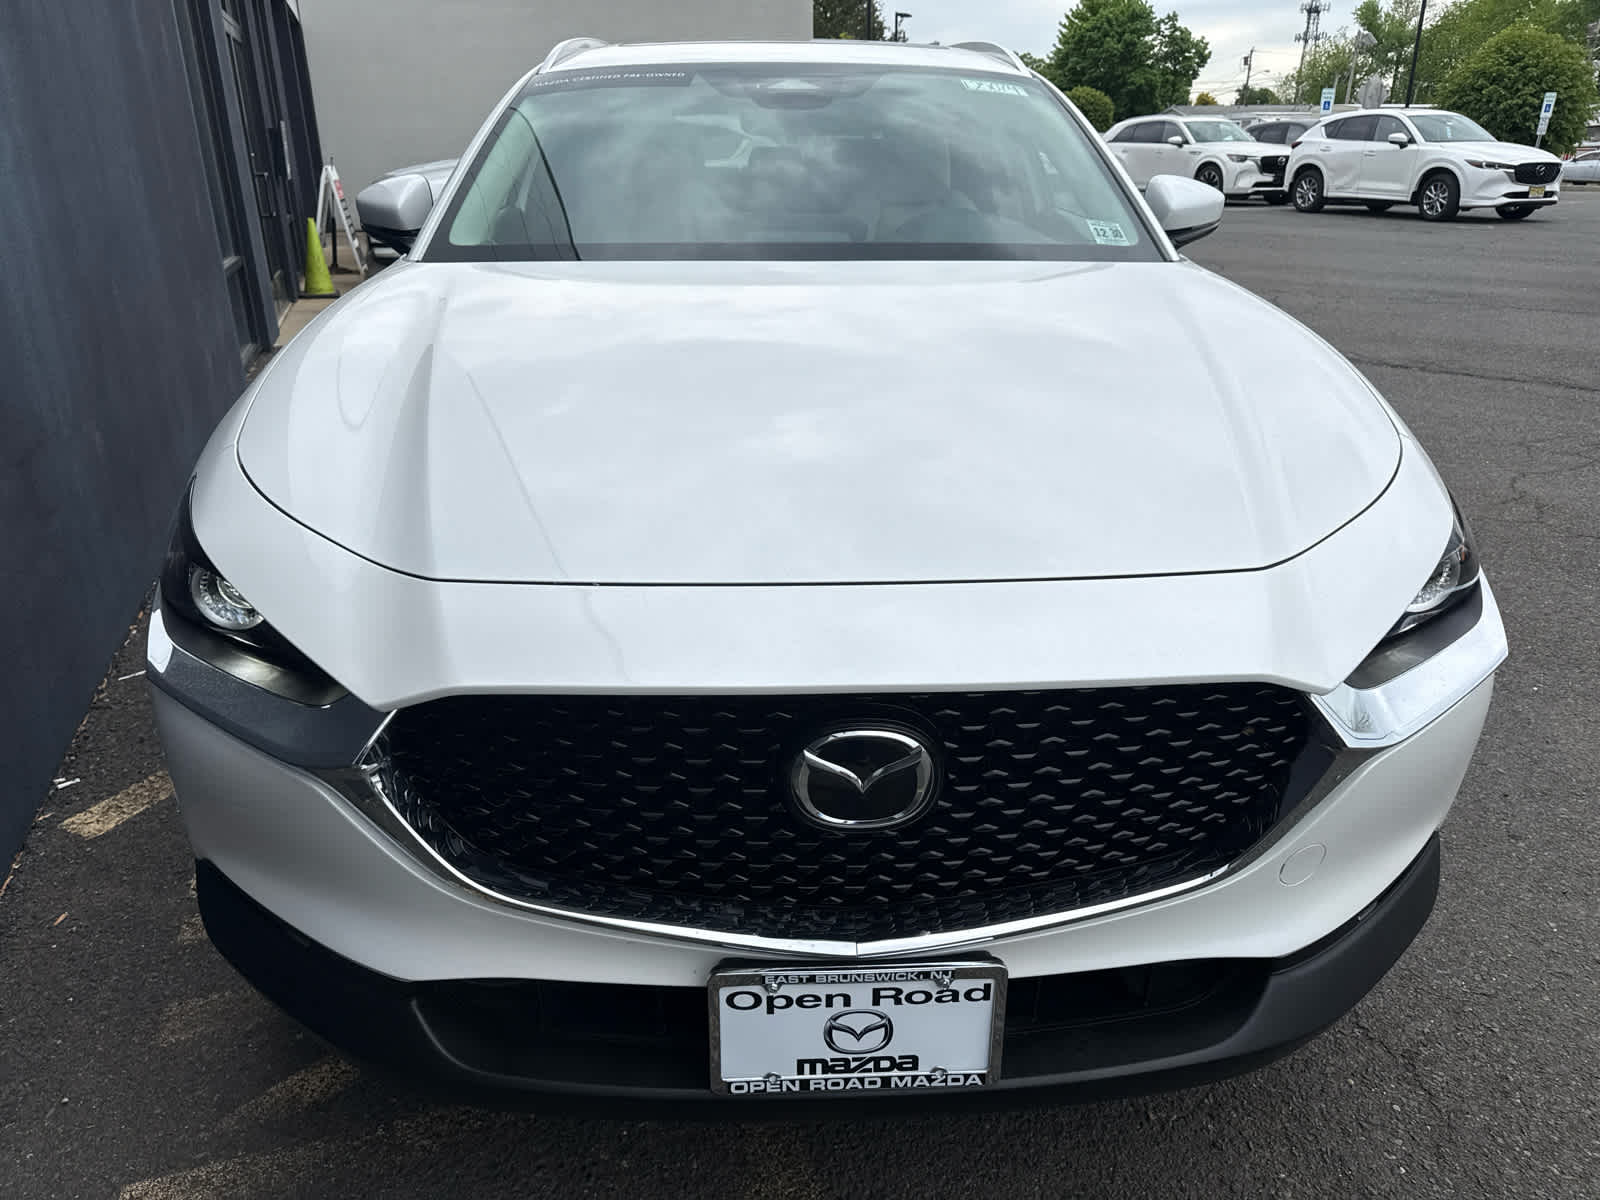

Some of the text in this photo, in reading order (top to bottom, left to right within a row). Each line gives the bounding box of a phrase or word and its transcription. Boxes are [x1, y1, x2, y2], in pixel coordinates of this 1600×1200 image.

[764, 975, 810, 985] EAST
[930, 971, 952, 980] NJ
[725, 983, 992, 1015] Open Road
[730, 1074, 983, 1094] OPEN ROAD MAZDA
